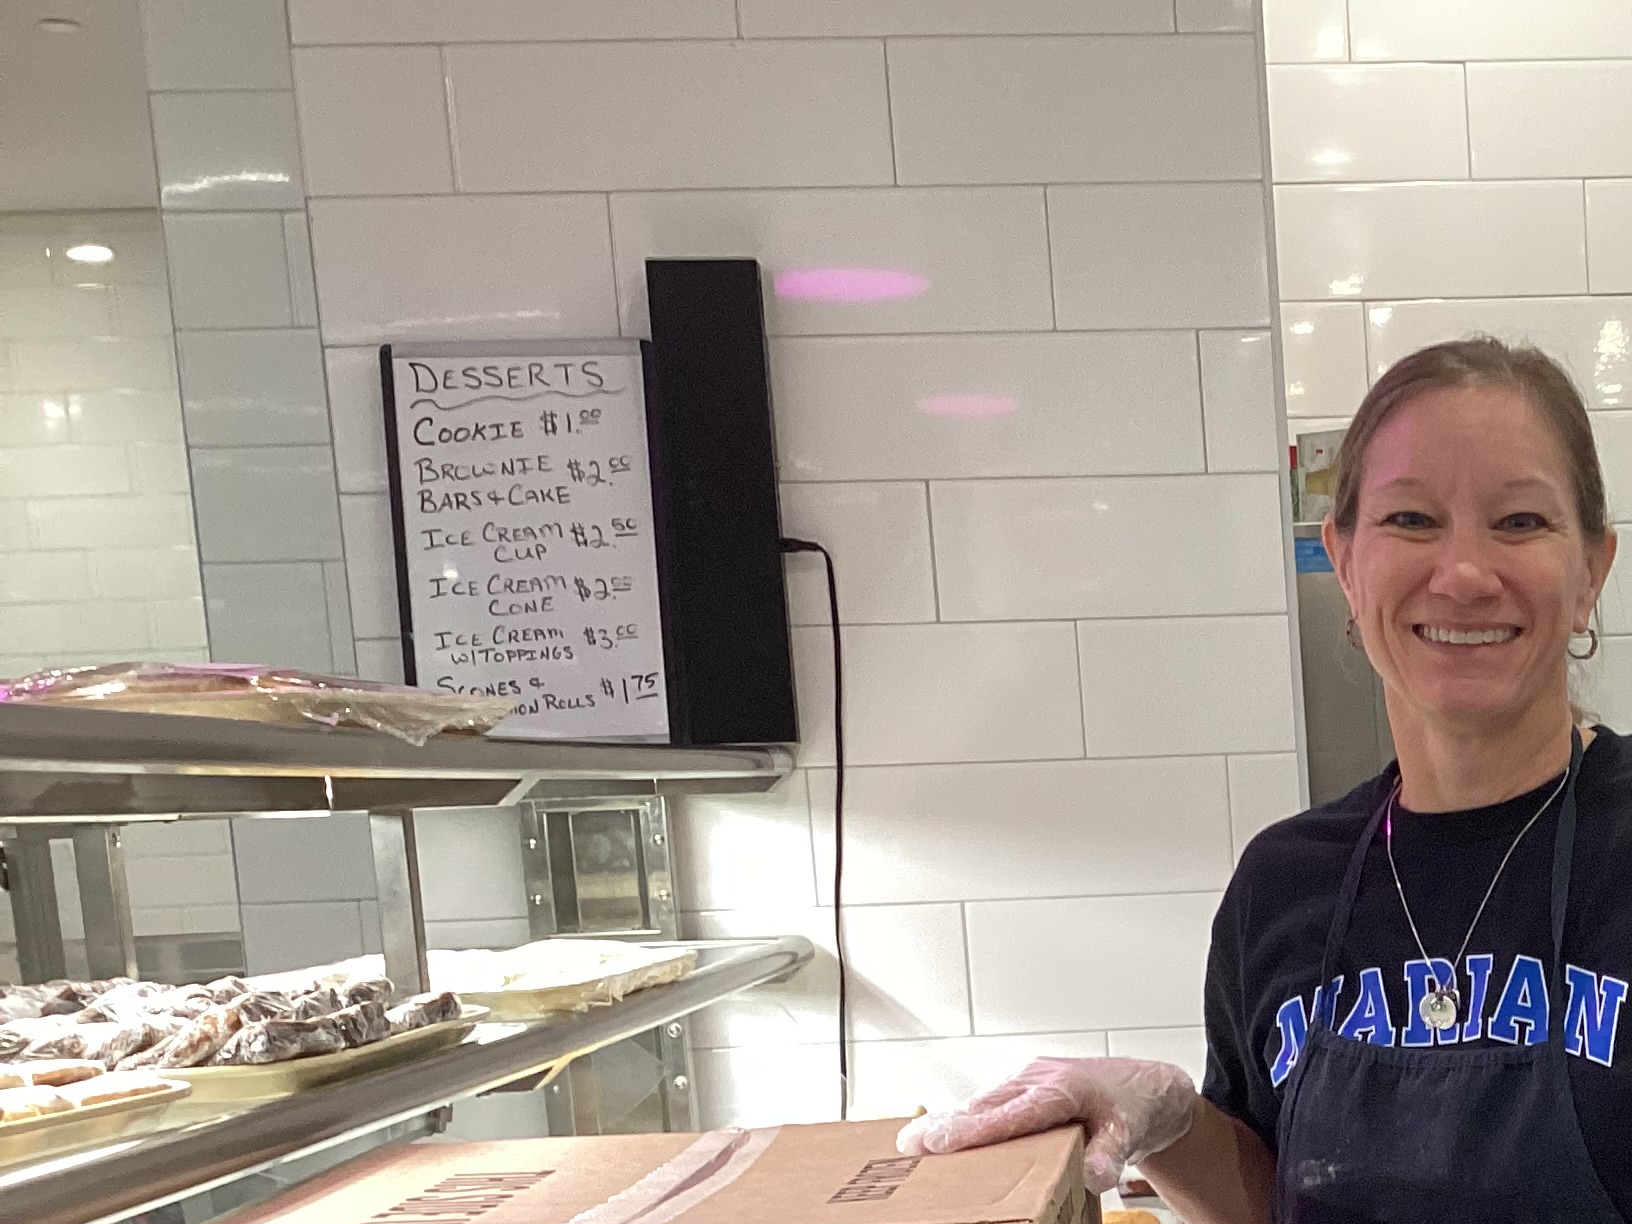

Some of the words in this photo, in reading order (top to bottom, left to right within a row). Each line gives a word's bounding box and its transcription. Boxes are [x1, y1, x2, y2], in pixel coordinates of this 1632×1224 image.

[409, 361, 604, 393] DESSERTS
[413, 416, 524, 446] COOKIE
[414, 455, 553, 485] BROWNIE
[421, 528, 475, 551] ICE
[494, 543, 547, 563] CUP
[429, 577, 480, 599] ICE
[488, 596, 555, 617] CONE
[434, 631, 483, 651] ICE
[543, 693, 596, 710] ROLLS
